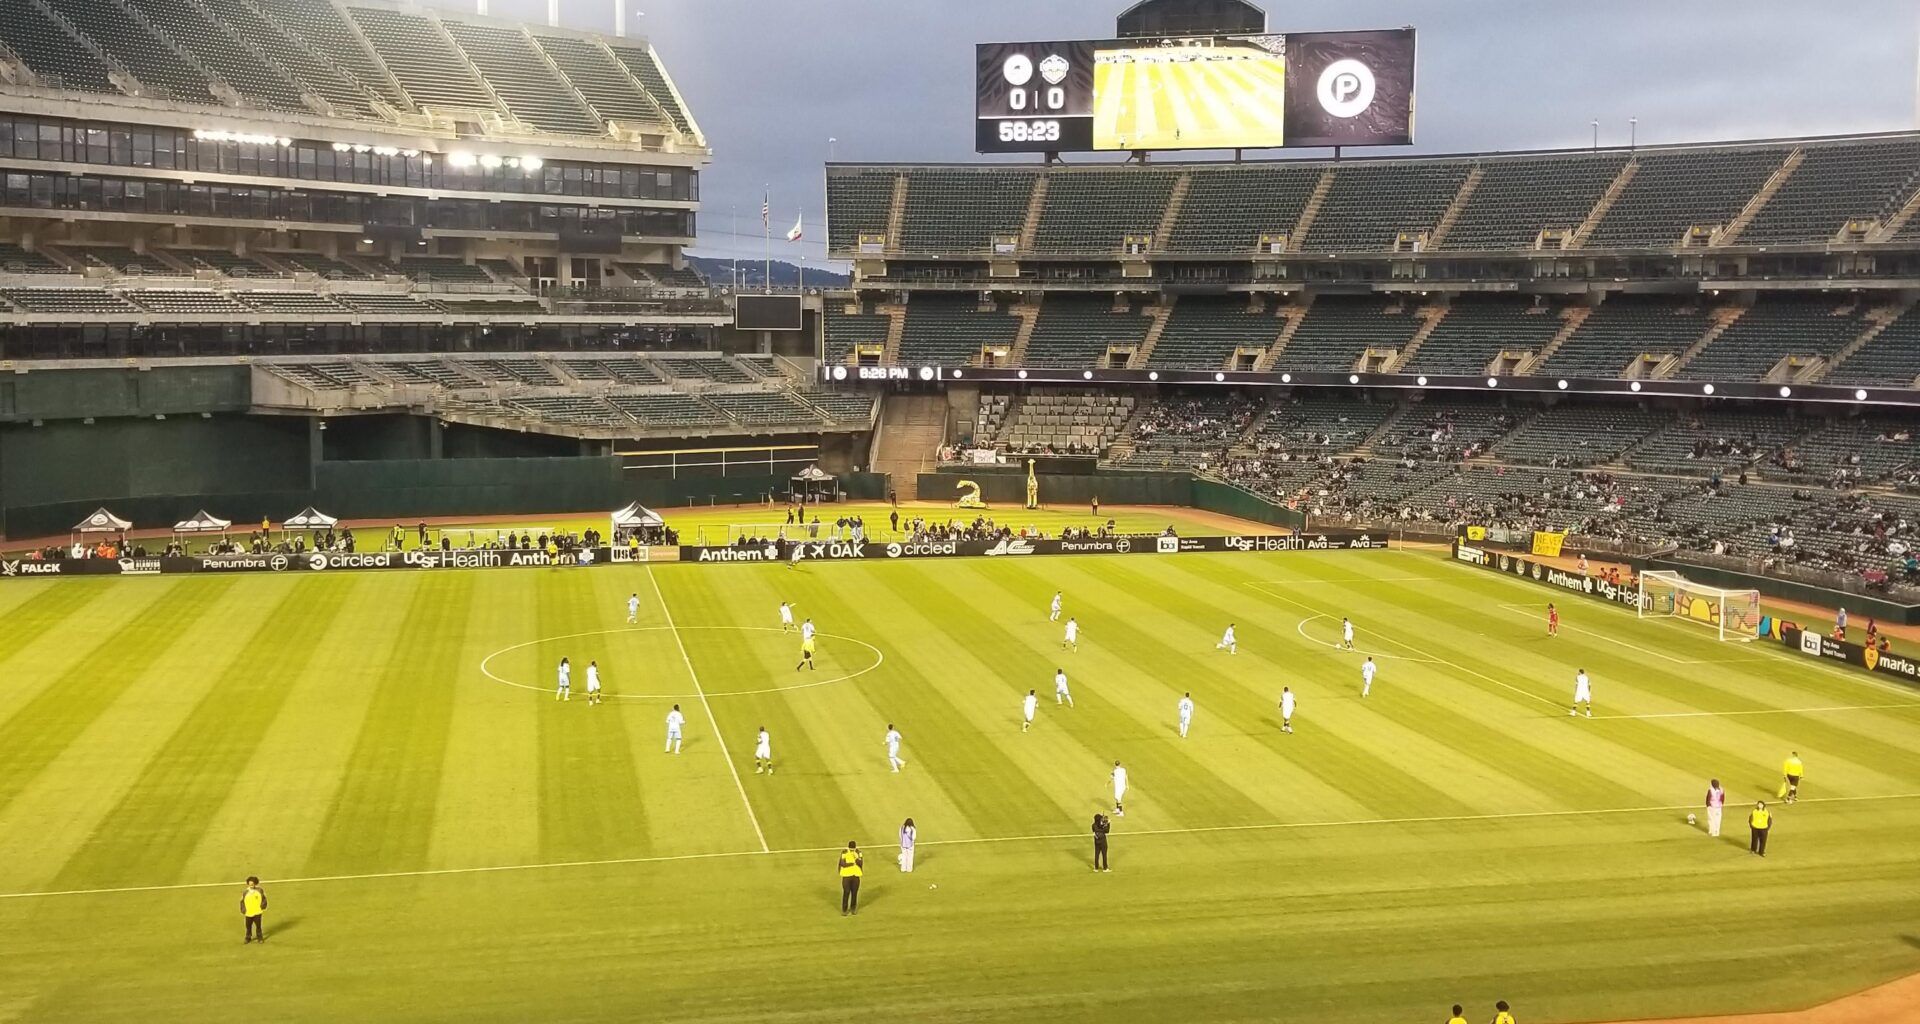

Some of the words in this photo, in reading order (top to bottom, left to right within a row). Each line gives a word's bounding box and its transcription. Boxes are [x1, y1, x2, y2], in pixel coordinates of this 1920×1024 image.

[1009, 88, 1026, 110] 0
[1047, 87, 1064, 109] 0
[999, 121, 1060, 142] 58:23
[889, 368, 908, 379] PM
[1061, 541, 1113, 551] Penumbra
[1225, 537, 1254, 551] UCSF
[1256, 535, 1304, 551] Health
[1307, 540, 1327, 549] Ava
[1350, 540, 1370, 548] Ava
[1536, 534, 1562, 546] NEVER
[509, 551, 576, 566] Anthm
[699, 547, 763, 562] Anthem
[830, 544, 864, 558] OAK
[203, 558, 266, 569] Penumbra
[403, 551, 439, 568] UCSF
[441, 551, 501, 568] Health
[22, 563, 60, 573] FALCK
[1547, 569, 1582, 592] Anthem
[1596, 579, 1617, 600] UCSF
[1617, 584, 1653, 611] Heath
[1879, 656, 1915, 676] marka
